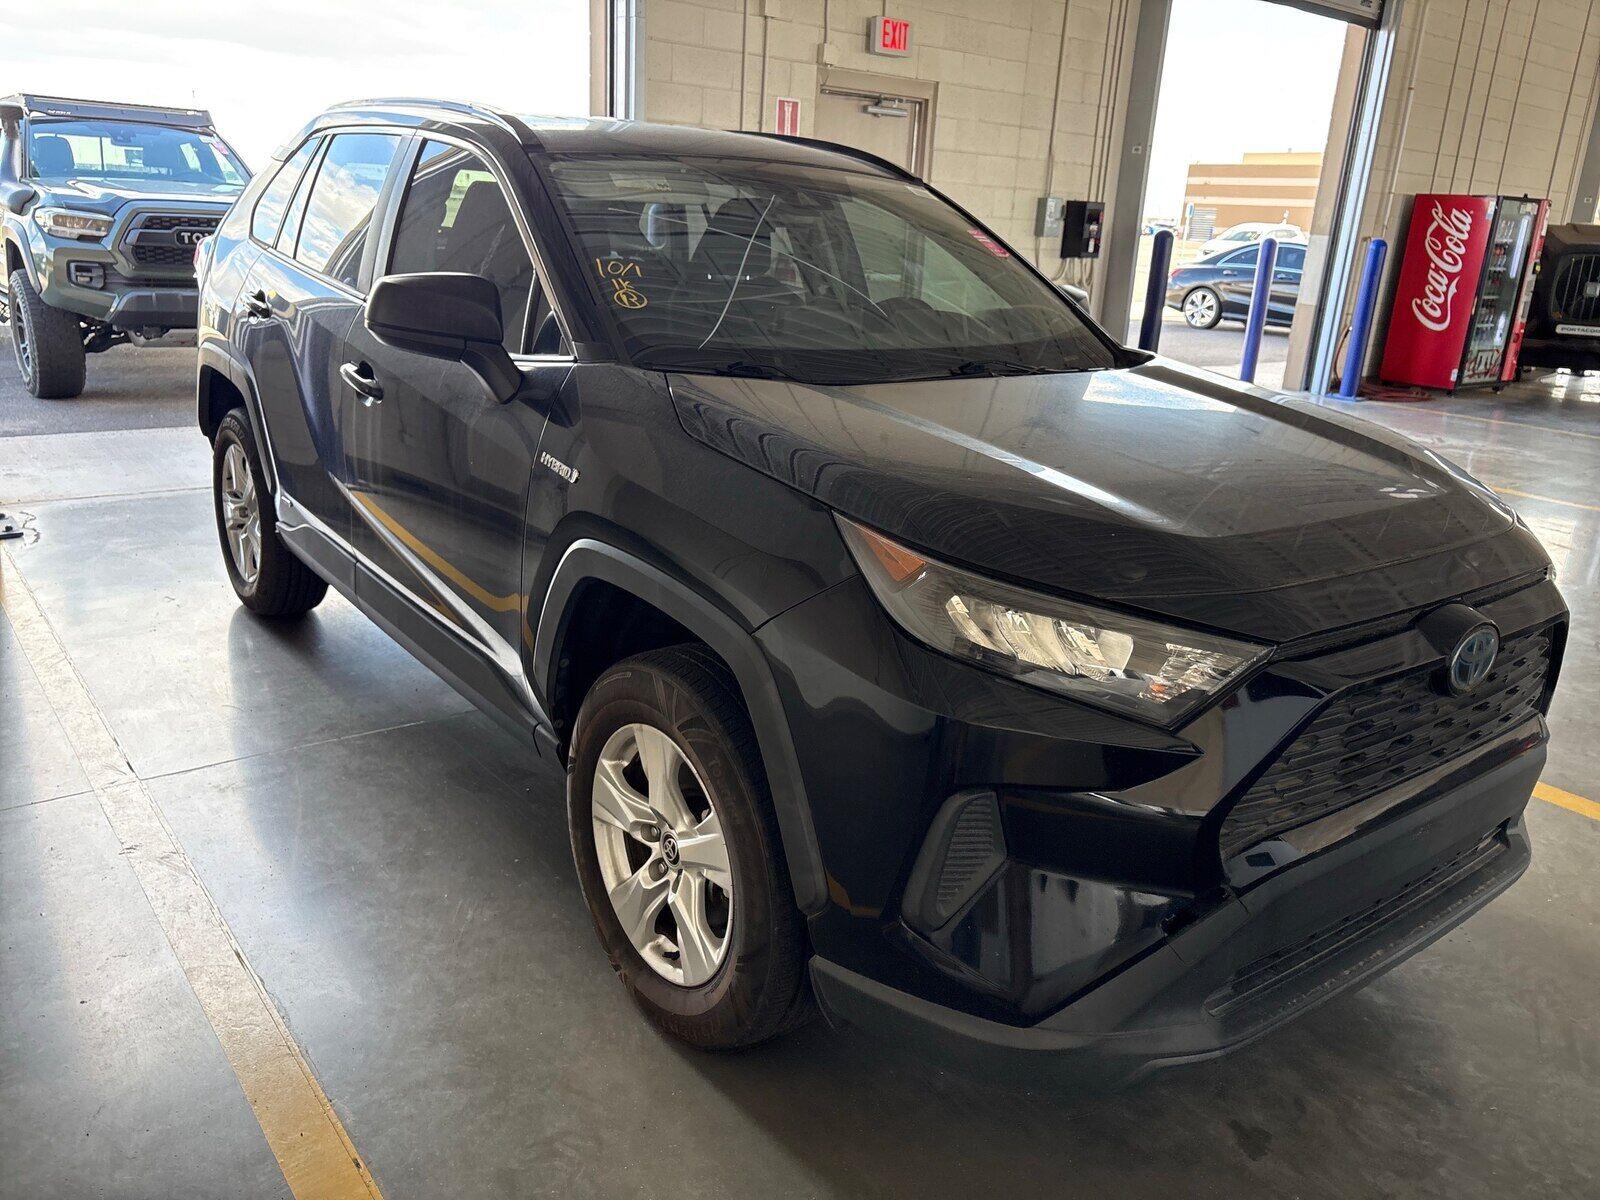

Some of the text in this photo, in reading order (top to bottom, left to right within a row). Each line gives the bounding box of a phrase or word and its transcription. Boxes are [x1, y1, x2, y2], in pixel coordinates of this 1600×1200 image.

[882, 19, 910, 50] EXIT
[1411, 199, 1474, 331] Coca-Cola
[540, 451, 571, 480] HYBRID
